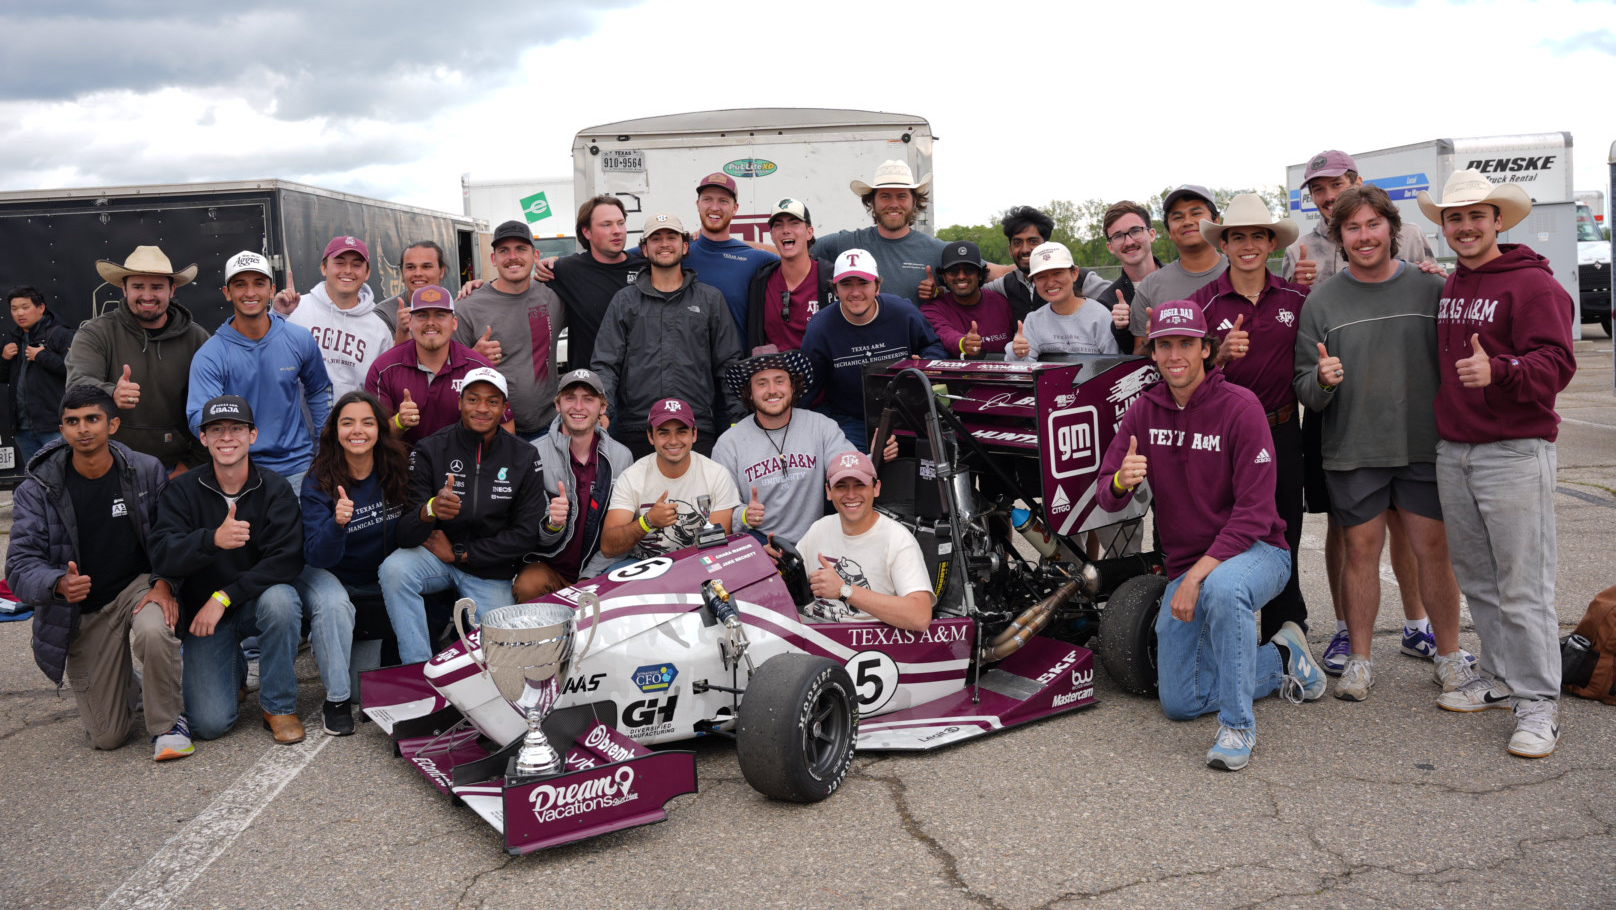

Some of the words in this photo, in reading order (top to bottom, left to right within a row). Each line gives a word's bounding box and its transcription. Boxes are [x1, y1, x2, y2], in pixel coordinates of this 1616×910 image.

[1466, 156, 1556, 173] PENSKE
[1487, 175, 1507, 184] Truck
[1509, 173, 1538, 183] Rental
[233, 254, 260, 268] Aggies
[1159, 308, 1179, 322] AGGIE
[1180, 308, 1194, 320] DAD
[1438, 298, 1464, 319] EXAS
[311, 326, 366, 363] GGIES
[991, 332, 1008, 342] FSAE
[851, 345, 870, 353] TEXAS
[871, 342, 886, 350] A&M
[870, 350, 908, 363] ENGINEERING
[1058, 423, 1092, 461] gm
[1191, 433, 1221, 452] A&M
[745, 454, 787, 482] TEXAS
[787, 453, 817, 469] A&M
[1254, 456, 1271, 464] adidas
[761, 471, 806, 486] UNIVERSITY
[355, 504, 375, 515] TEXAS
[1052, 504, 1070, 514] CITGO
[347, 519, 375, 533] HANICAL
[617, 559, 666, 579] 5
[722, 559, 735, 567] JAKE
[848, 627, 915, 646] TEXAS
[920, 625, 968, 644] A&M
[1036, 650, 1077, 684] SKF
[562, 672, 607, 695] AAS
[636, 673, 662, 686] CFO
[856, 658, 884, 705] 5
[1052, 687, 1094, 708] Mastercam
[629, 723, 672, 735] DIVERSIFIED
[529, 772, 620, 812] Dream
[534, 795, 613, 823] Vacations
